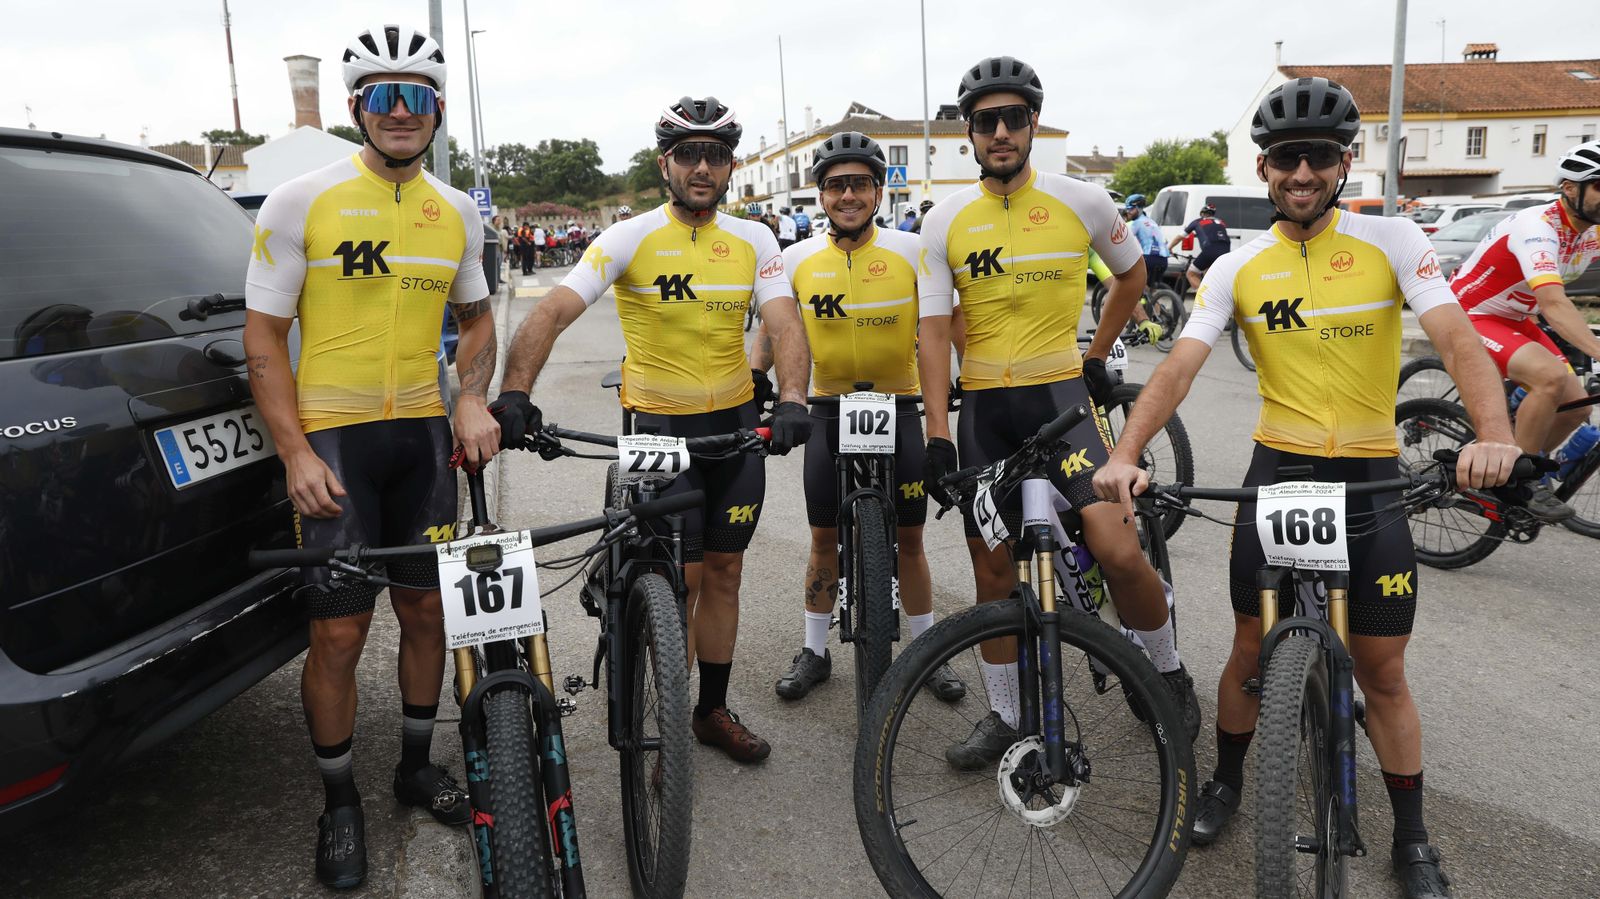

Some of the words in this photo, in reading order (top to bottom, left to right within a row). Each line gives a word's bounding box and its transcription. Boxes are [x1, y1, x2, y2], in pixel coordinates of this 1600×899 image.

[474, 191, 485, 203] P
[339, 208, 379, 216] FASTER
[401, 277, 450, 294] STORE
[1015, 269, 1064, 285] STORE
[705, 300, 746, 312] STORE
[856, 314, 900, 327] STORE
[1319, 323, 1375, 340] STORE
[0, 416, 78, 439] OCUS
[846, 409, 890, 435] 102
[182, 413, 264, 470] 5525
[174, 462, 183, 475] E
[628, 450, 681, 473] 221
[1265, 507, 1337, 546] 168
[454, 566, 523, 617] 167
[499, 621, 541, 632] emergencias
[1170, 768, 1187, 852] PIRELLI
